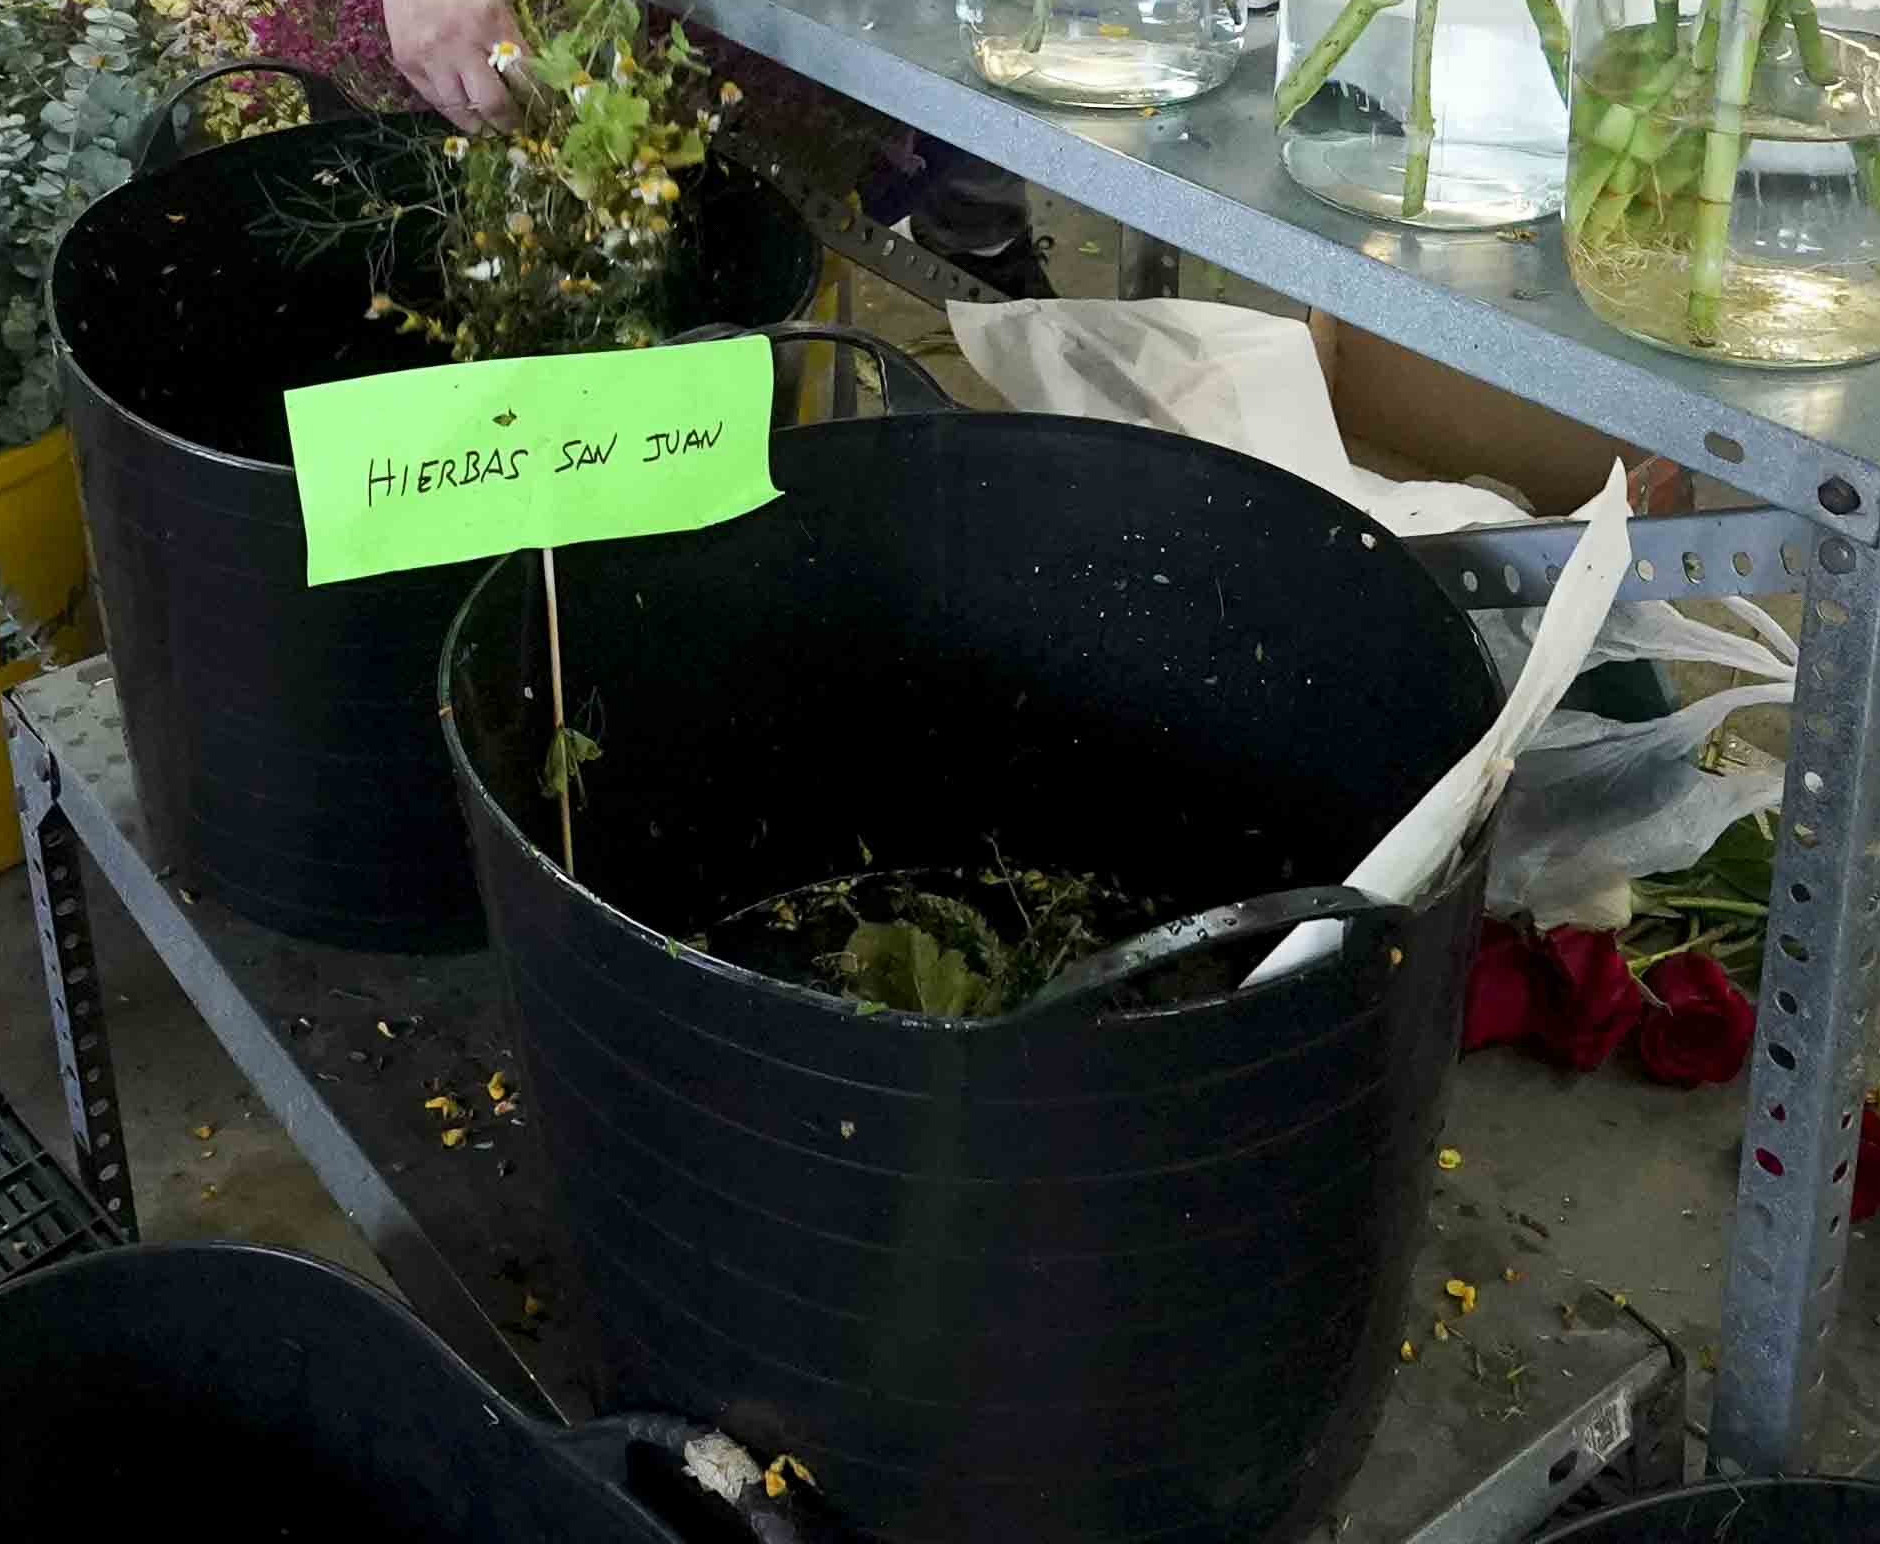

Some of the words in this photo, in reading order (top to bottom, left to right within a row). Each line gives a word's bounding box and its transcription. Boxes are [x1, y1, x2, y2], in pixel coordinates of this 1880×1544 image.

[366, 449, 529, 508] HIERBAS
[553, 432, 618, 474] SAN
[642, 421, 724, 464] JUAN
